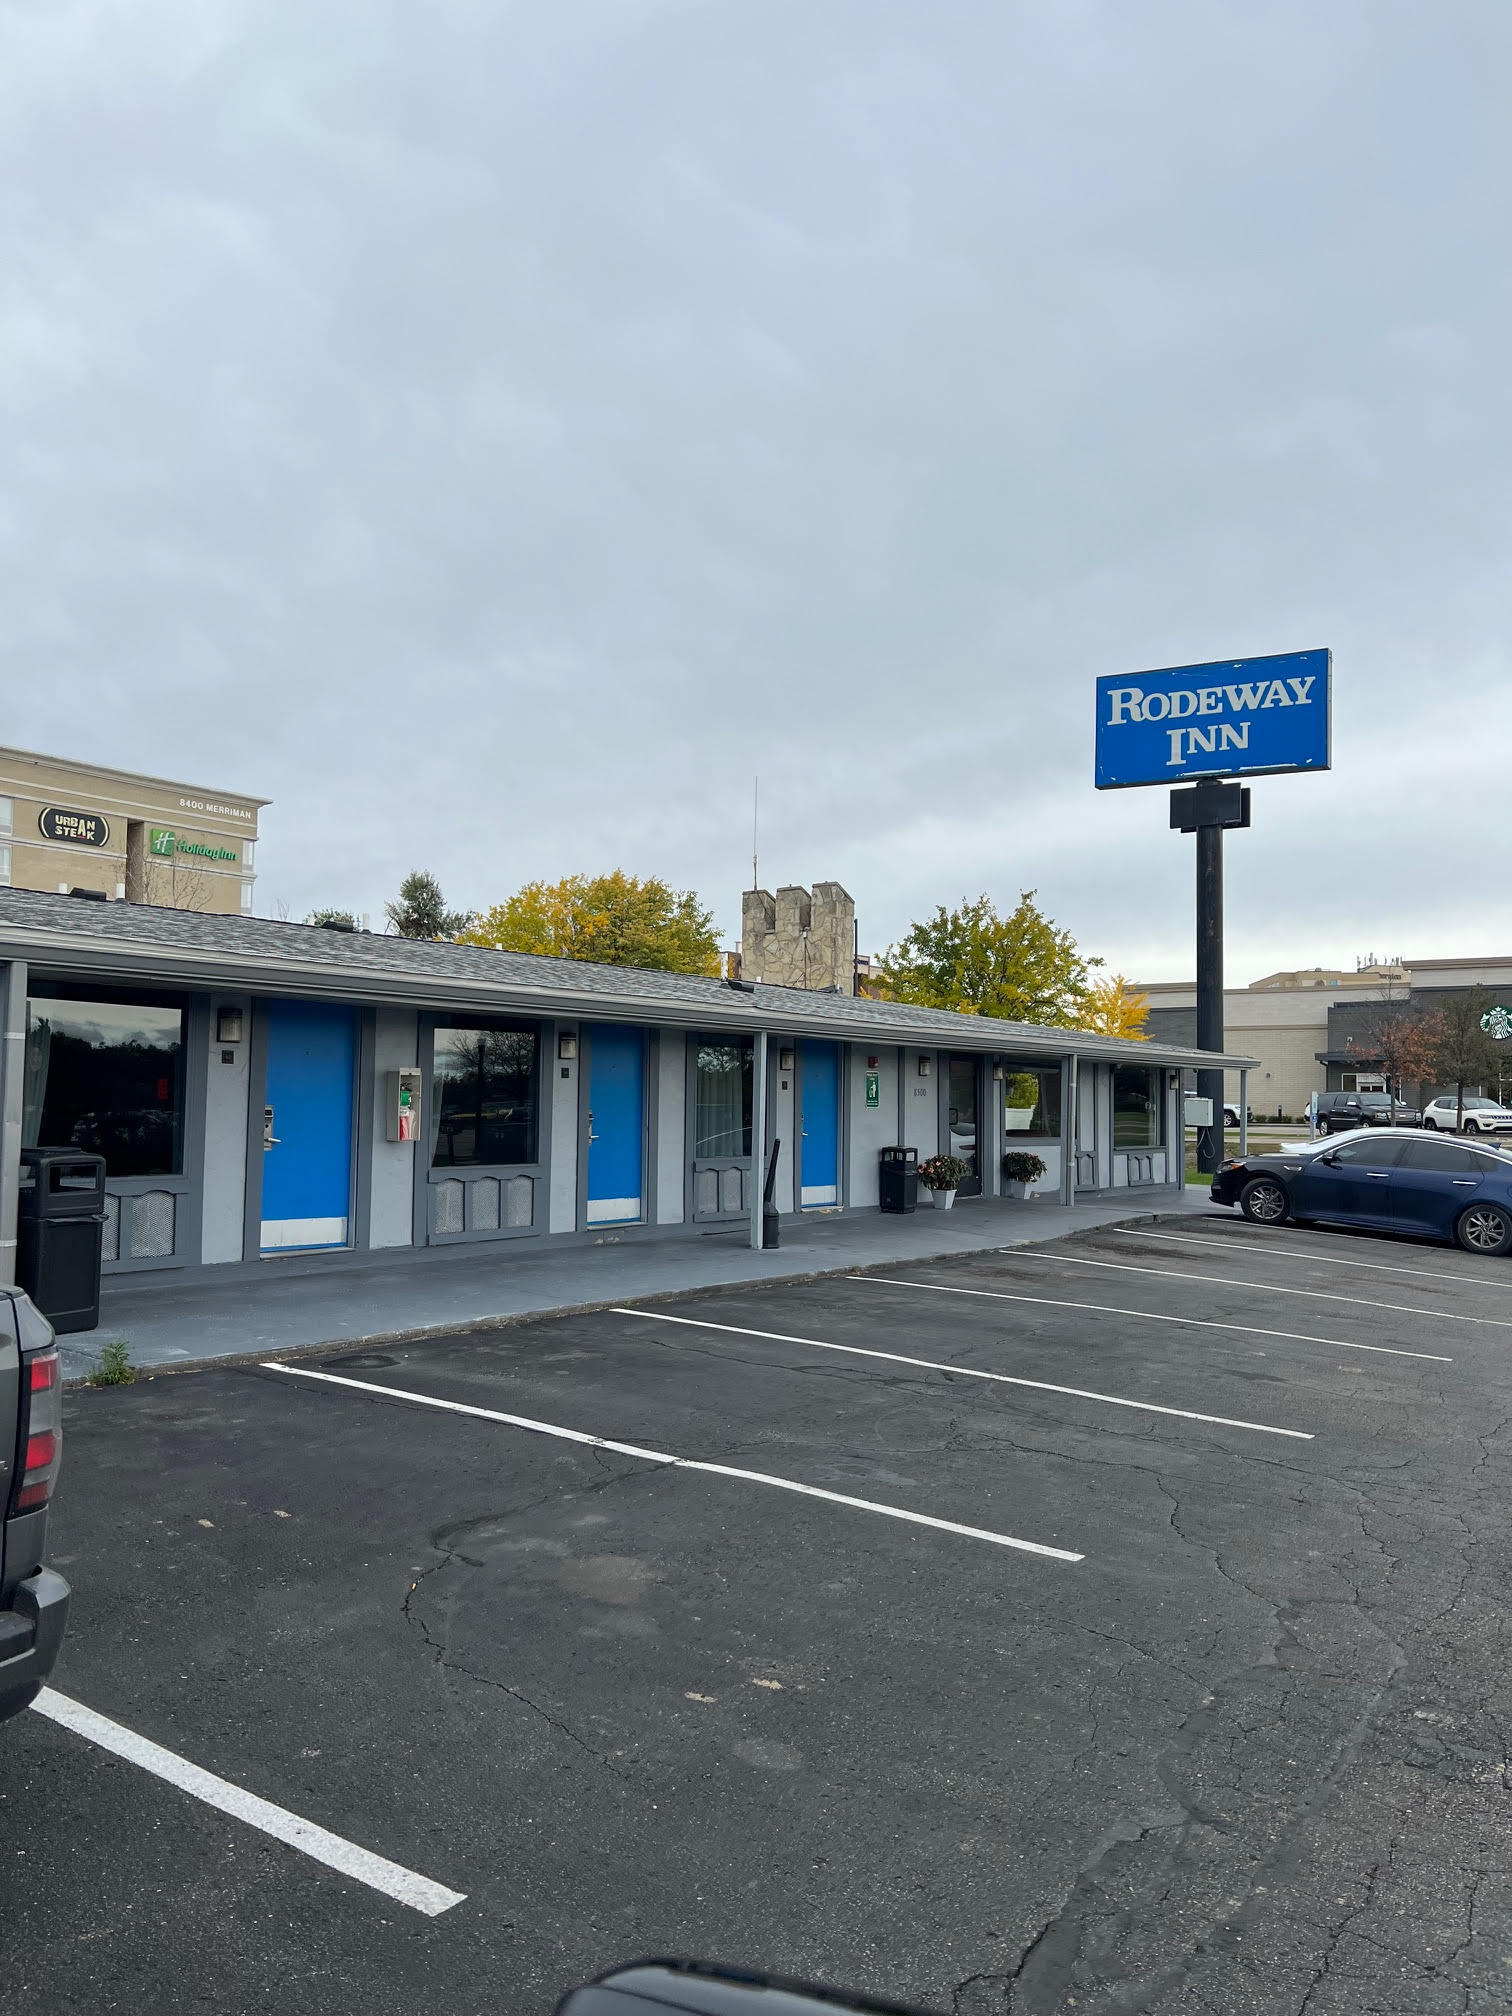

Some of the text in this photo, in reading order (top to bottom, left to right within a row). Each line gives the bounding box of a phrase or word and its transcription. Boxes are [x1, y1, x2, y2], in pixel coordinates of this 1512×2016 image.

[1107, 676, 1316, 725] RODEWAY
[1166, 722, 1250, 765] INN
[179, 798, 251, 819] 8400 MERRIMAN
[55, 815, 95, 832] URBAN
[55, 823, 95, 840] STEAK
[176, 840, 238, 861] Holiday Inn
